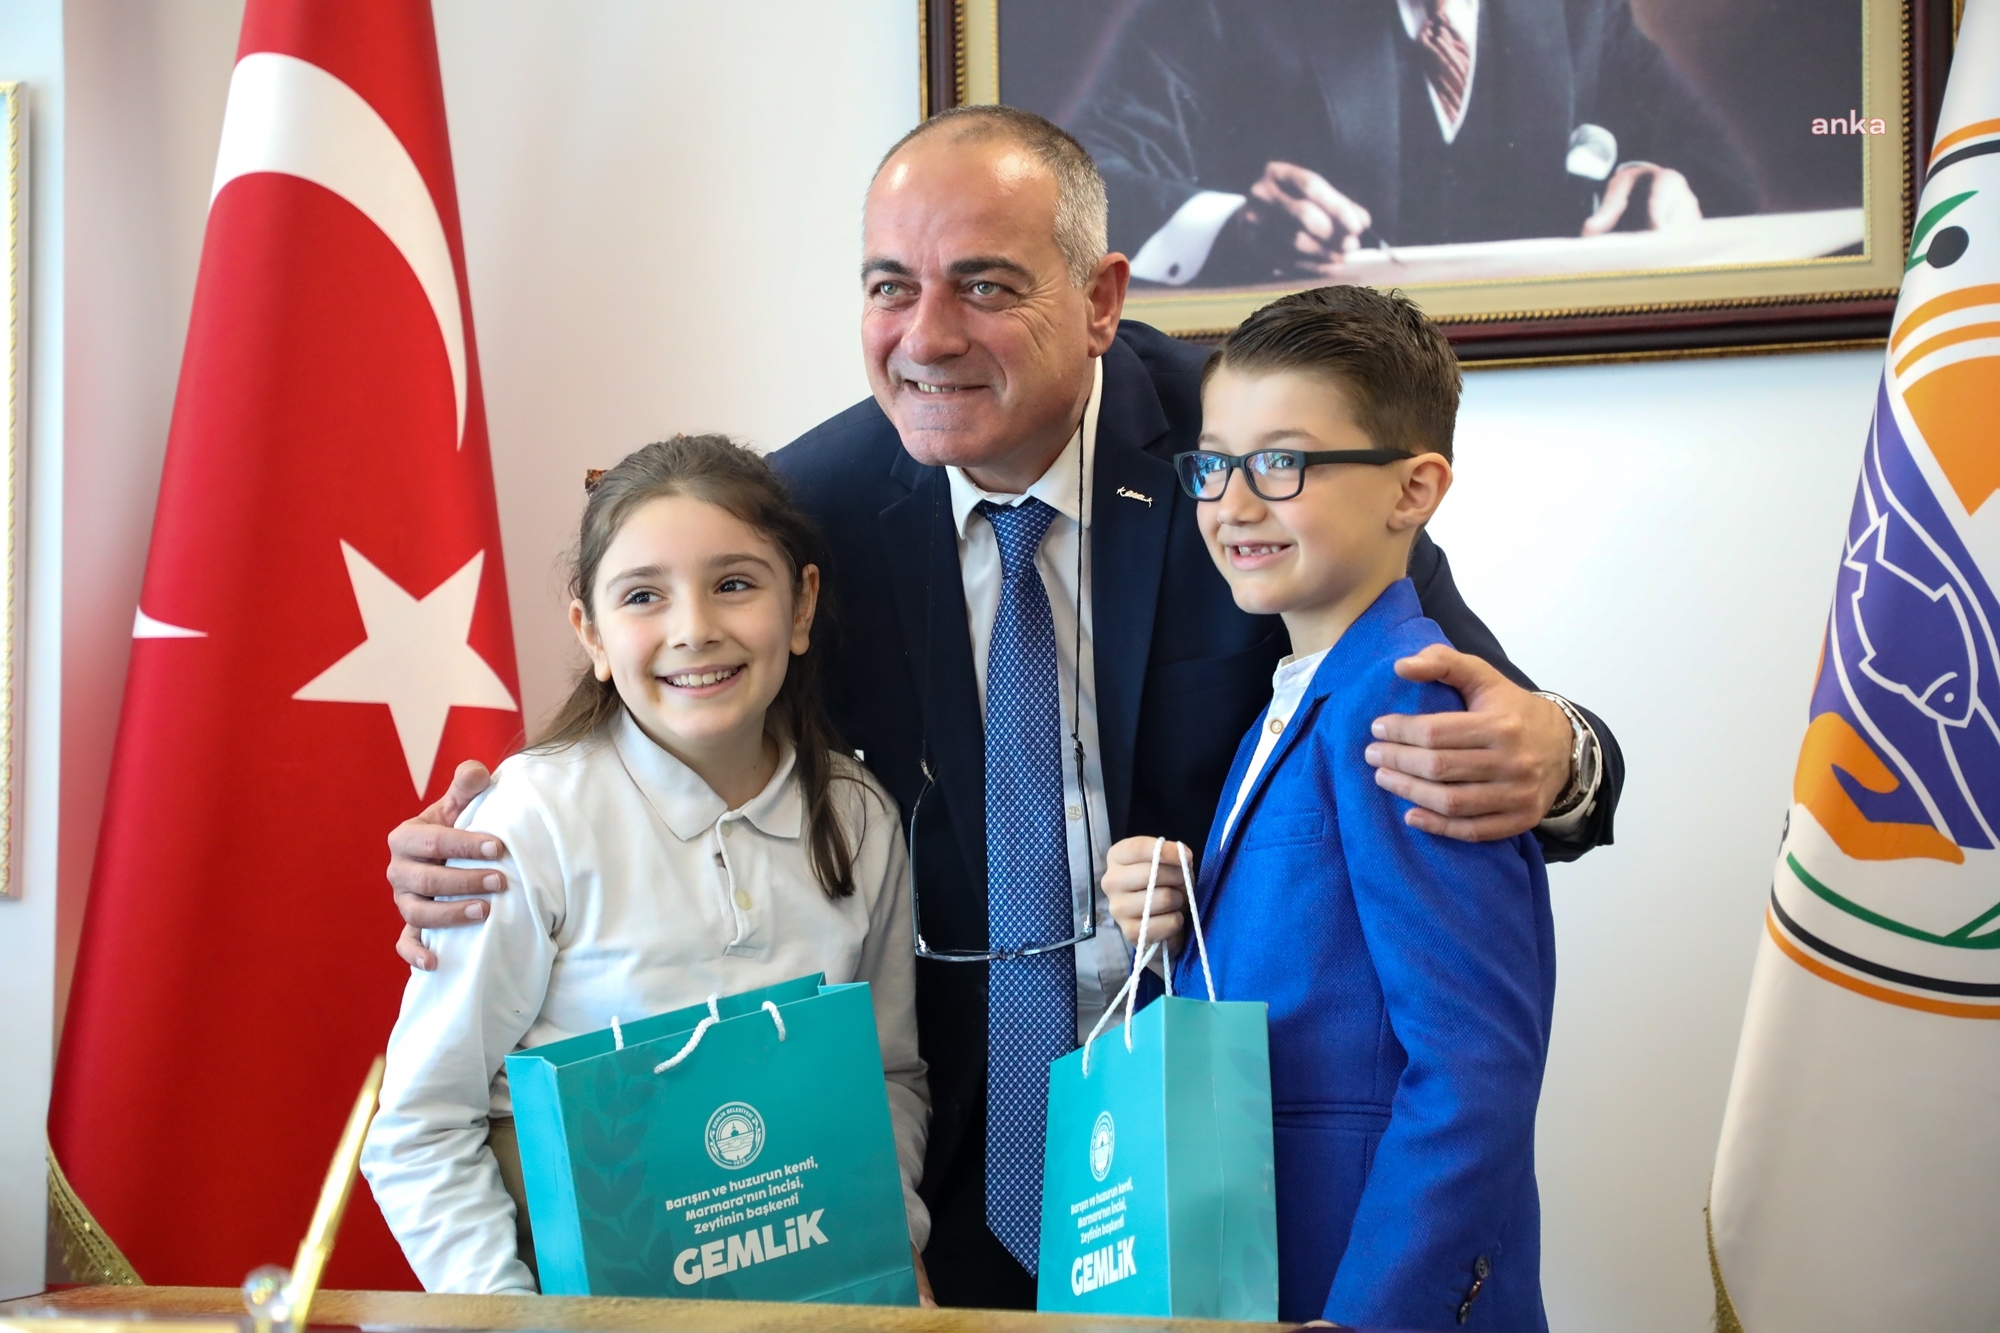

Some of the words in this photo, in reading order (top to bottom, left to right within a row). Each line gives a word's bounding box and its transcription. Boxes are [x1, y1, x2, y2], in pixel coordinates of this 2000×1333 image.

[665, 1190, 710, 1211] Barışın
[711, 1185, 727, 1197] ve
[729, 1168, 782, 1192] huzurun
[784, 1156, 818, 1176] kenti,
[746, 1192, 799, 1218] başkenti
